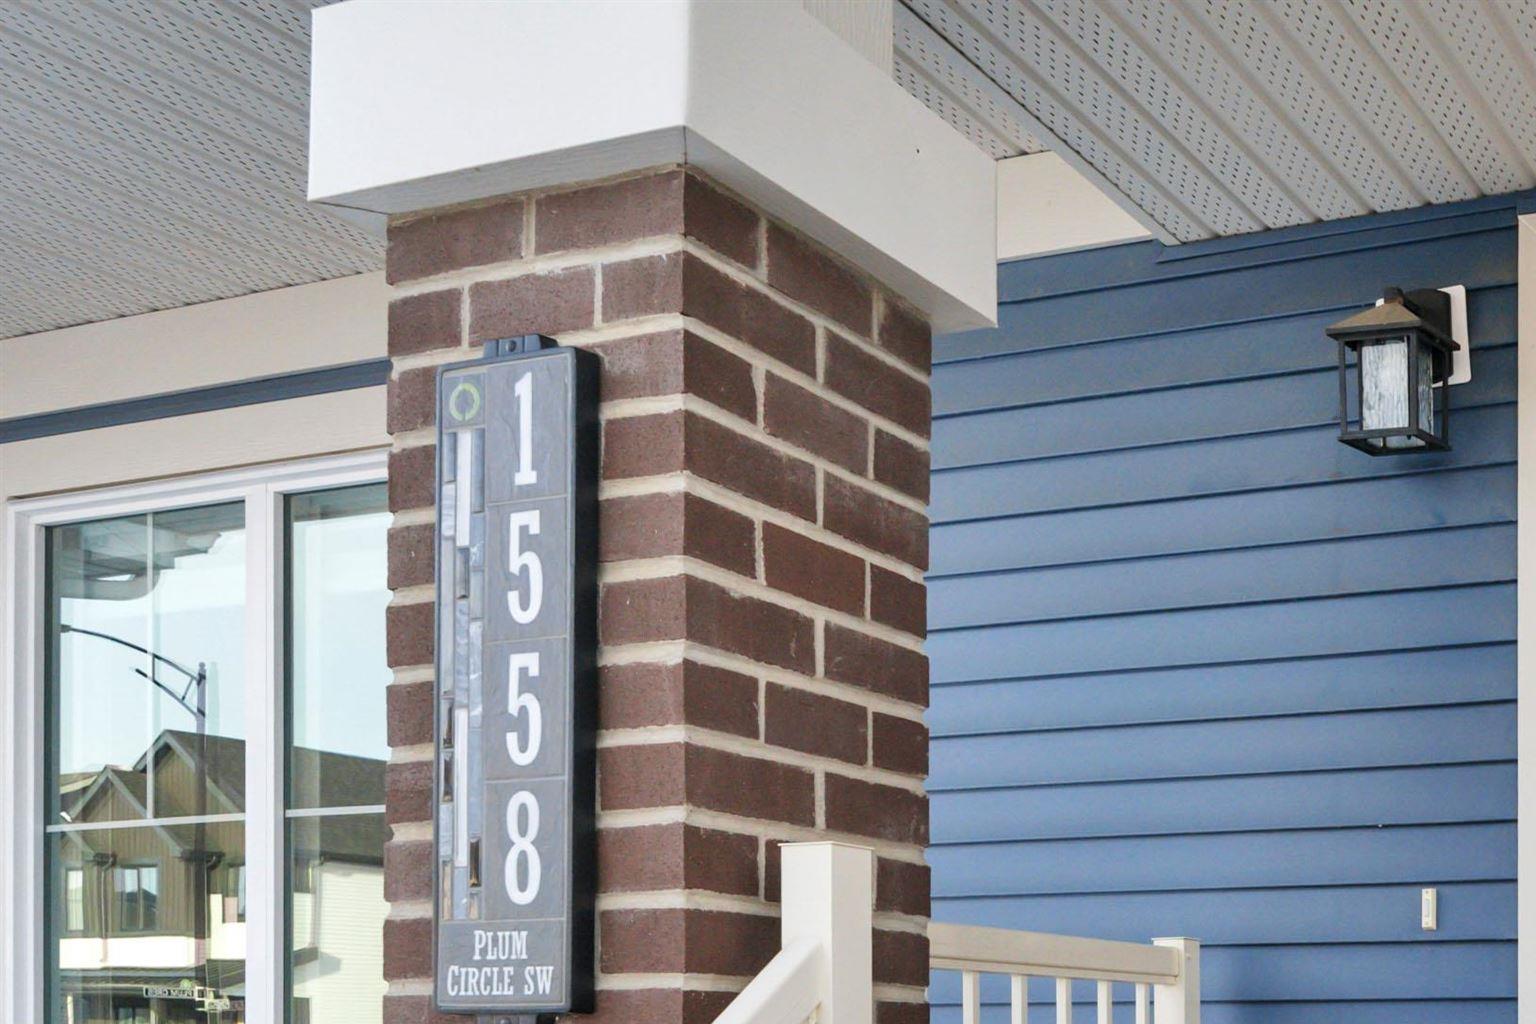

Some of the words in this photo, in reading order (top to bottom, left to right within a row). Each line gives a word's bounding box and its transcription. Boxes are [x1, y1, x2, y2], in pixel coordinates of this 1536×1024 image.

[504, 371, 543, 906] 1558
[472, 930, 528, 960] PLUM
[447, 965, 514, 996] CIRCLE
[524, 966, 554, 995] SW
